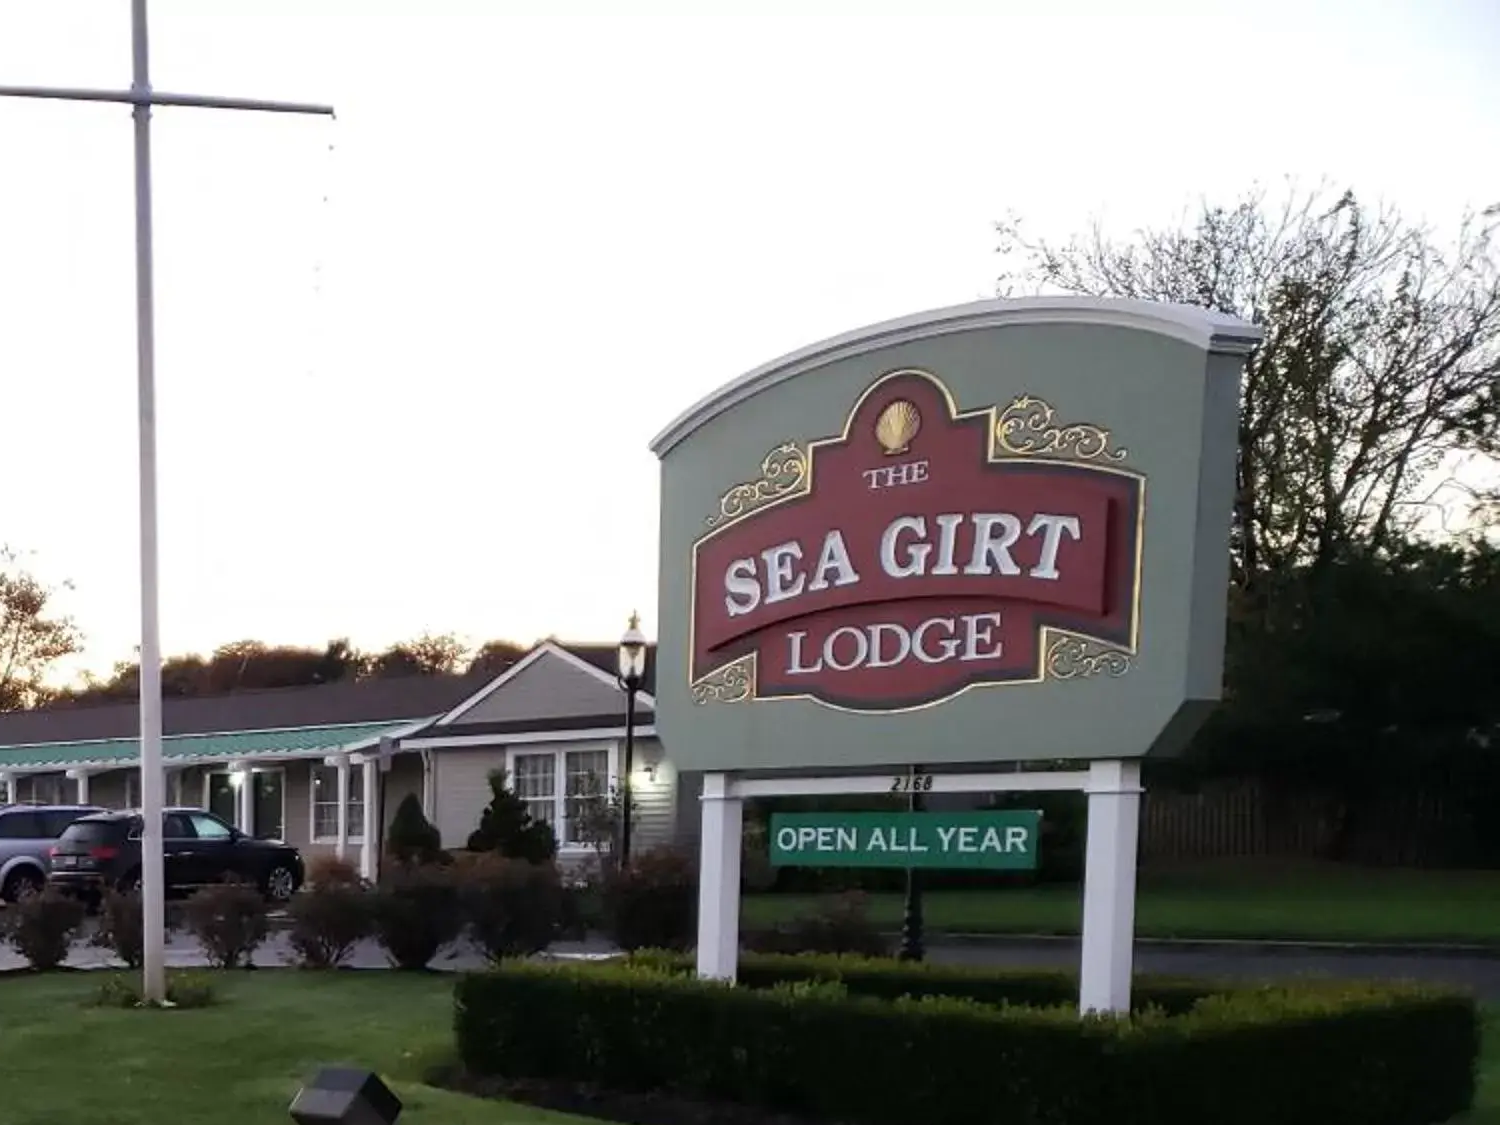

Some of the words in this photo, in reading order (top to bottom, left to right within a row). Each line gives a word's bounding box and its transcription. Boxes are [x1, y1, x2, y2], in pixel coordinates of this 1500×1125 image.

[864, 461, 929, 490] THE
[724, 531, 860, 617] SEA
[880, 513, 1081, 581] GIRT
[786, 614, 1002, 675] LODGE
[891, 775, 933, 791] 2168
[776, 827, 857, 852] OPEN
[866, 827, 928, 853] ALL
[937, 827, 1028, 852] YEAR
